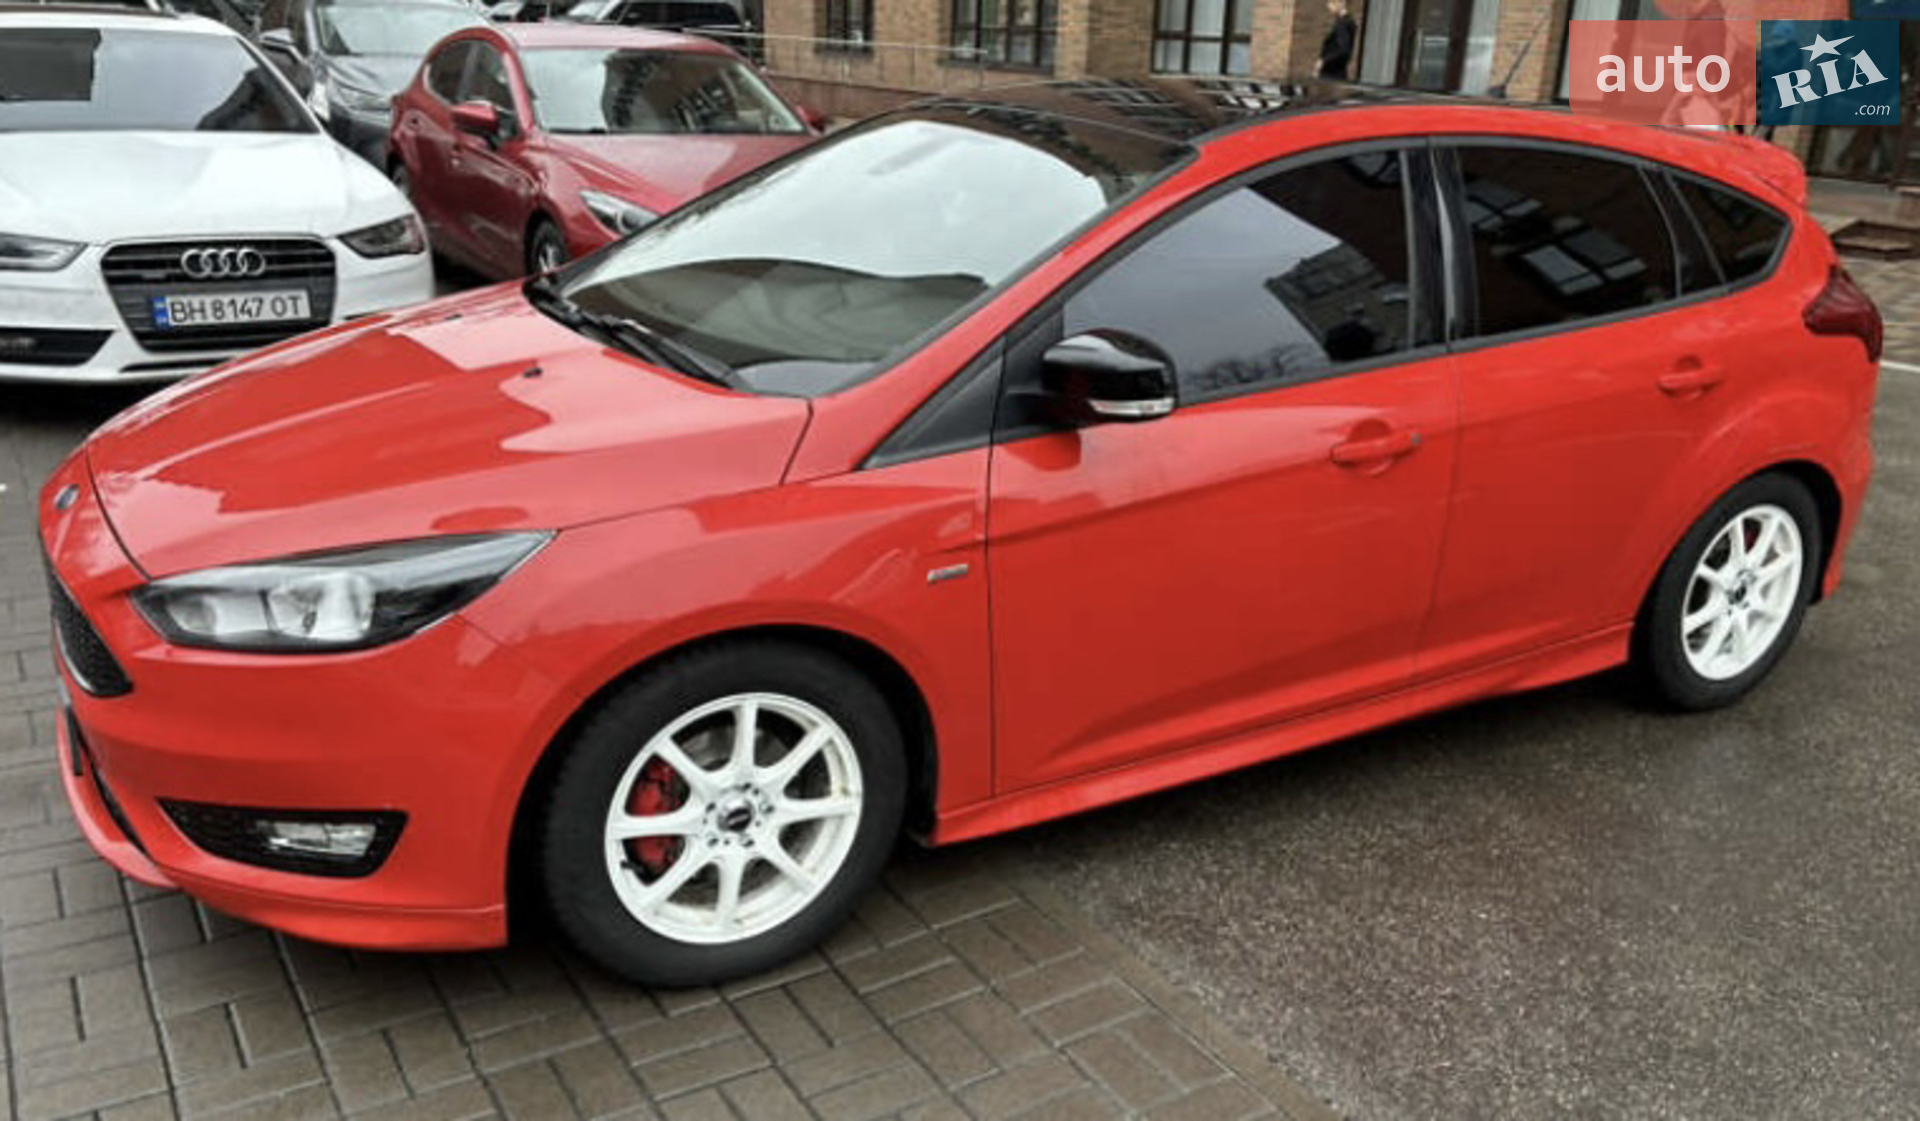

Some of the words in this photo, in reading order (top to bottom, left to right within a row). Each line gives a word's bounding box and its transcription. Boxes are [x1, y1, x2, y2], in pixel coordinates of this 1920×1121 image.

[170, 299, 207, 323] BH
[212, 296, 263, 320] 8147
[270, 295, 303, 318] OT
